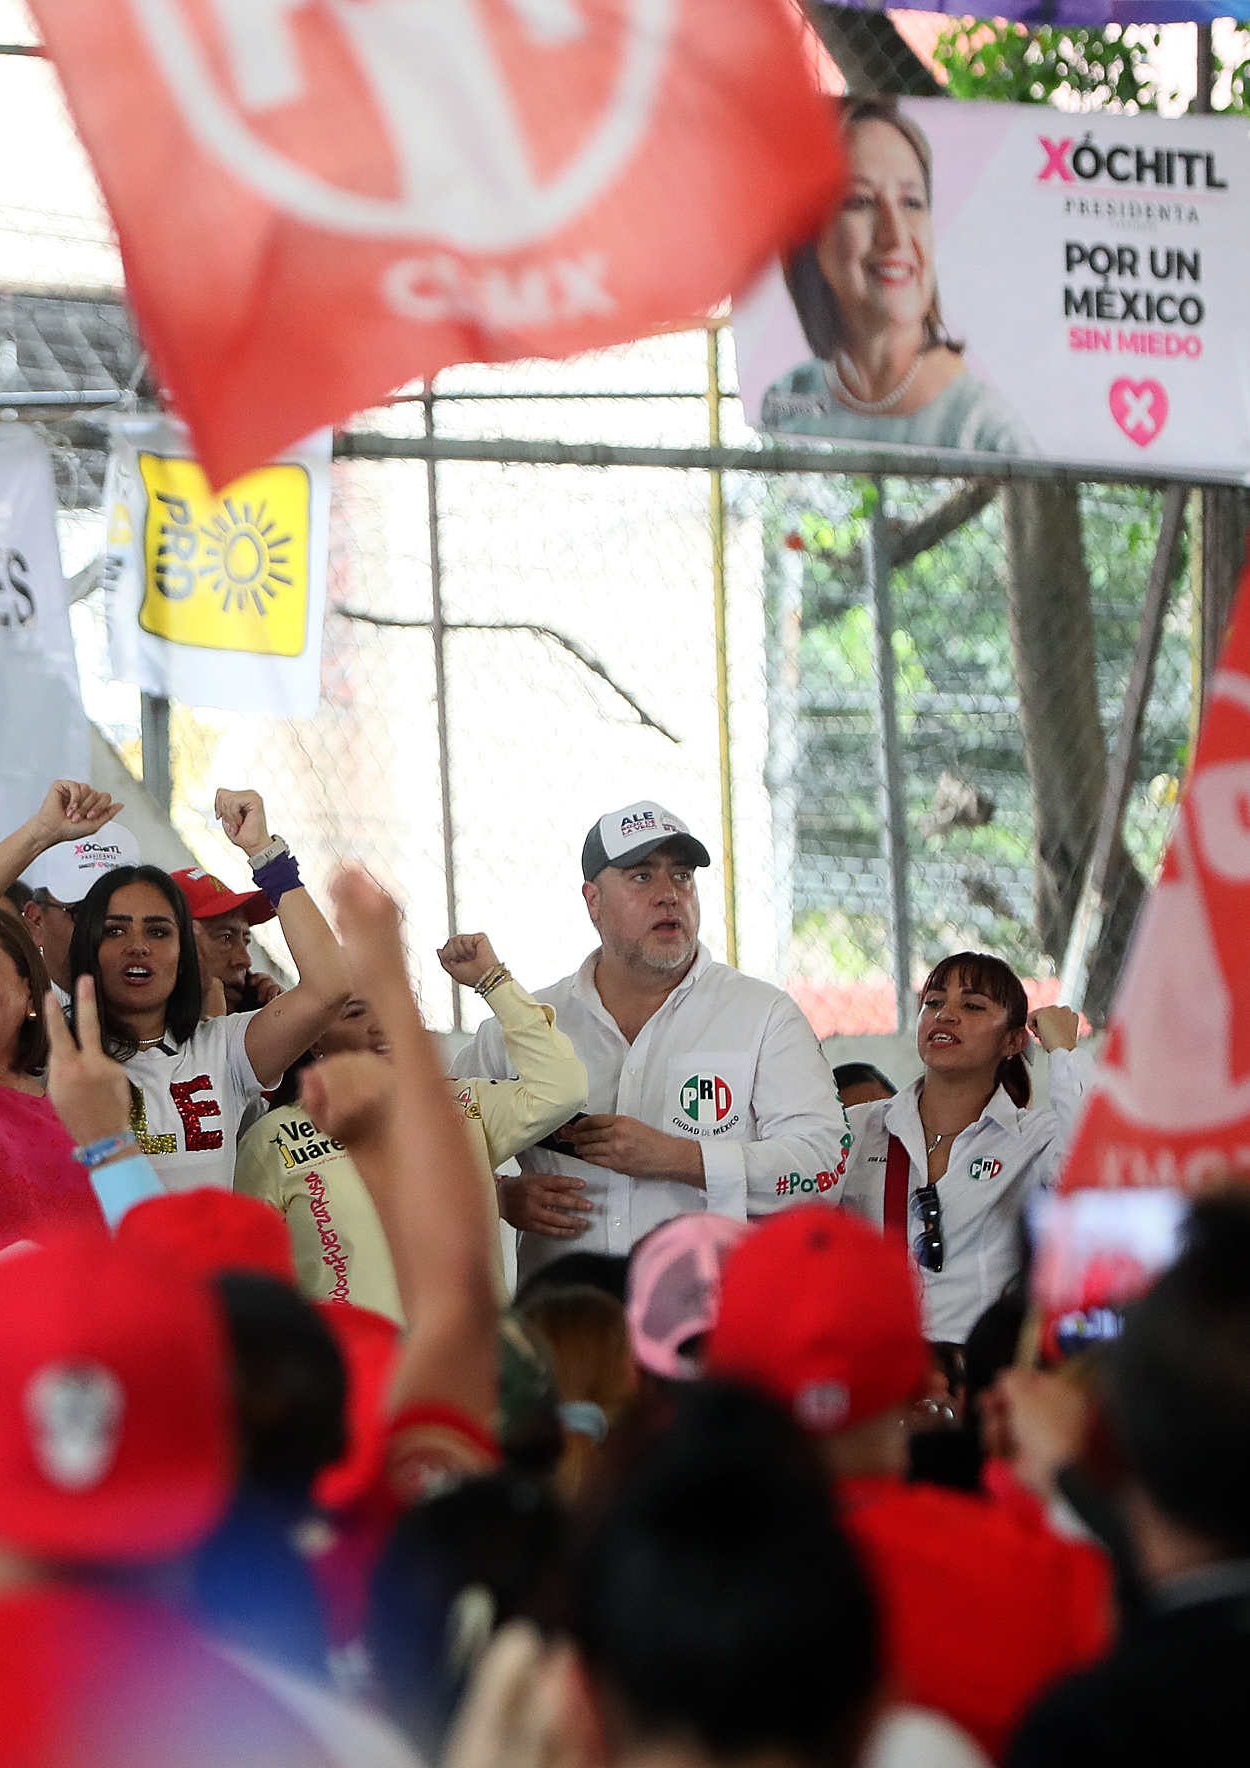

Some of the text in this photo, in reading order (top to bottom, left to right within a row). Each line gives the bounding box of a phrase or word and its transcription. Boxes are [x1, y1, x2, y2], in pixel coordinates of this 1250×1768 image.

[1036, 131, 1229, 189] XÓCHITL
[1064, 240, 1202, 282] POR UN
[1063, 274, 1205, 326] MÉXICO
[1069, 324, 1203, 360] SIN MIEDO
[155, 487, 198, 601] PRD
[621, 811, 655, 828] ALE
[682, 1079, 727, 1110] PRI
[672, 1117, 700, 1135] CIUDAD
[713, 1115, 740, 1136] MÉXICO
[971, 1160, 1000, 1177] PRI
